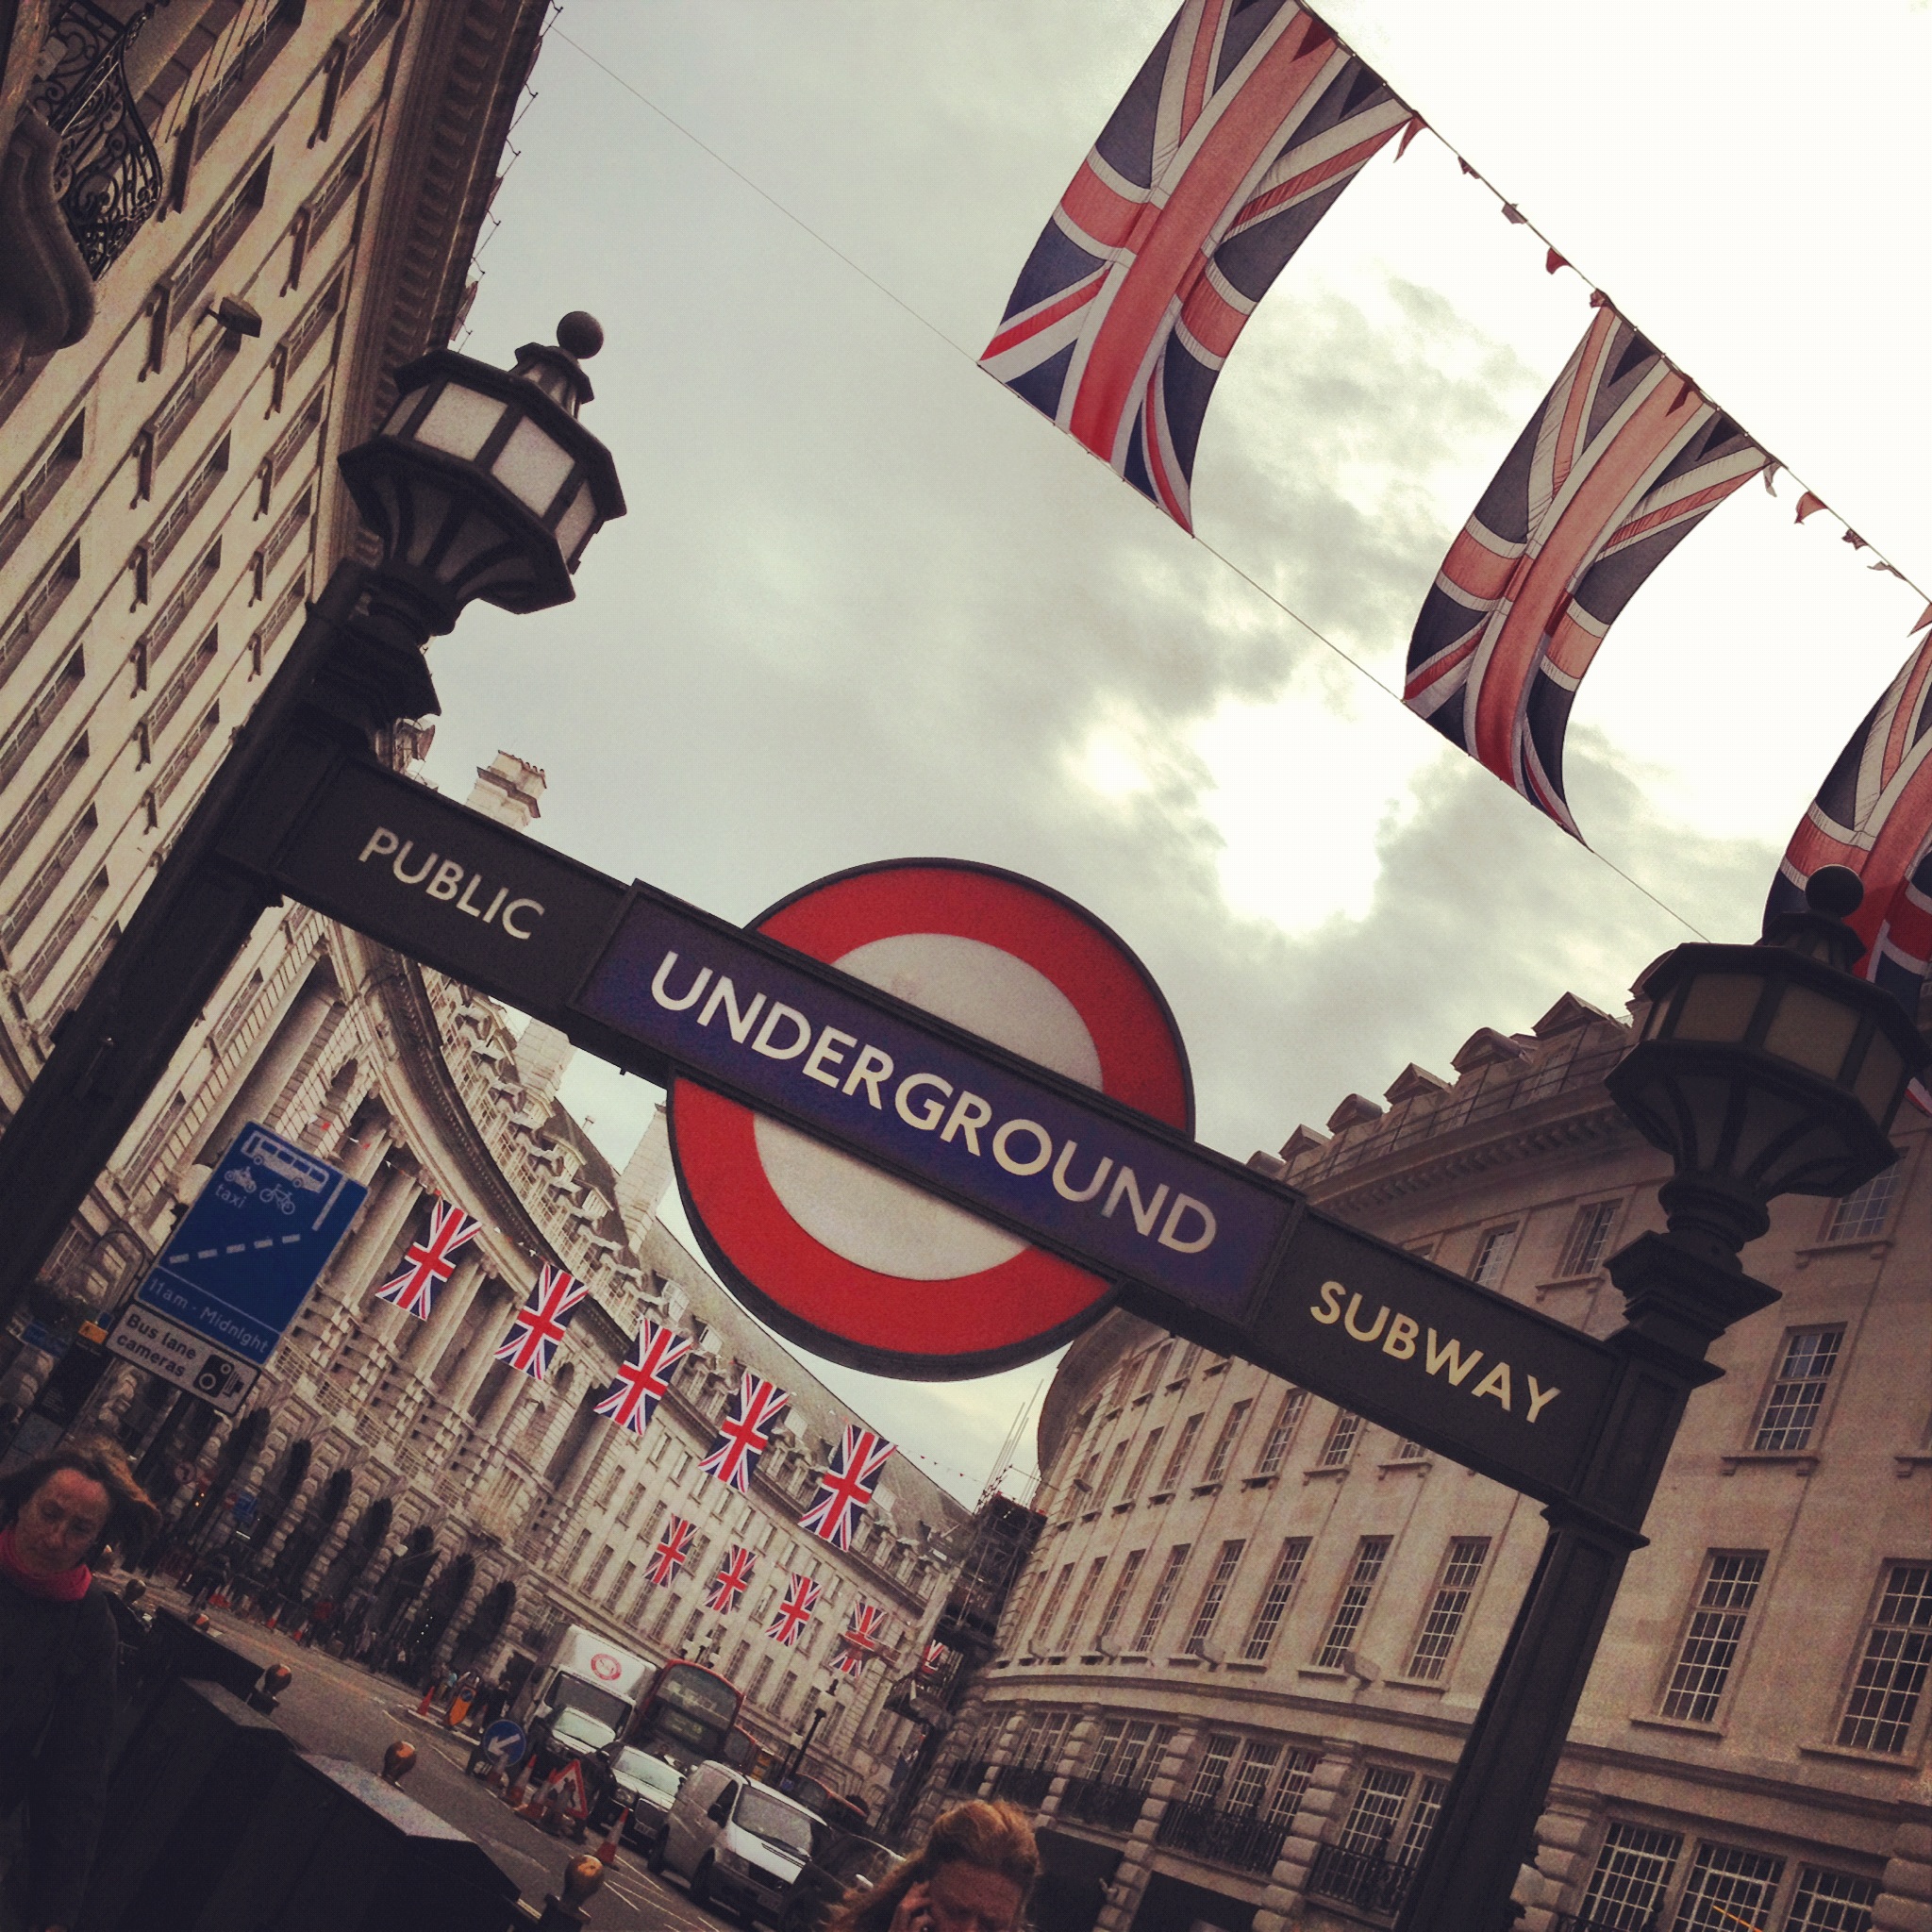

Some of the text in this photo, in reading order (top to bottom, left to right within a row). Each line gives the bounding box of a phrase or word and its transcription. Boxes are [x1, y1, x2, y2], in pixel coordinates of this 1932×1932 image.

[358, 826, 545, 940] PUBLIC
[651, 951, 1217, 1254] UNDERGROUND
[215, 1183, 247, 1208] taxi
[126, 1313, 196, 1359] Bus lane
[149, 1278, 189, 1309] 11am
[200, 1306, 269, 1354] Midnight
[1310, 1280, 1561, 1424] SUBWAY
[116, 1334, 185, 1377] cameras
